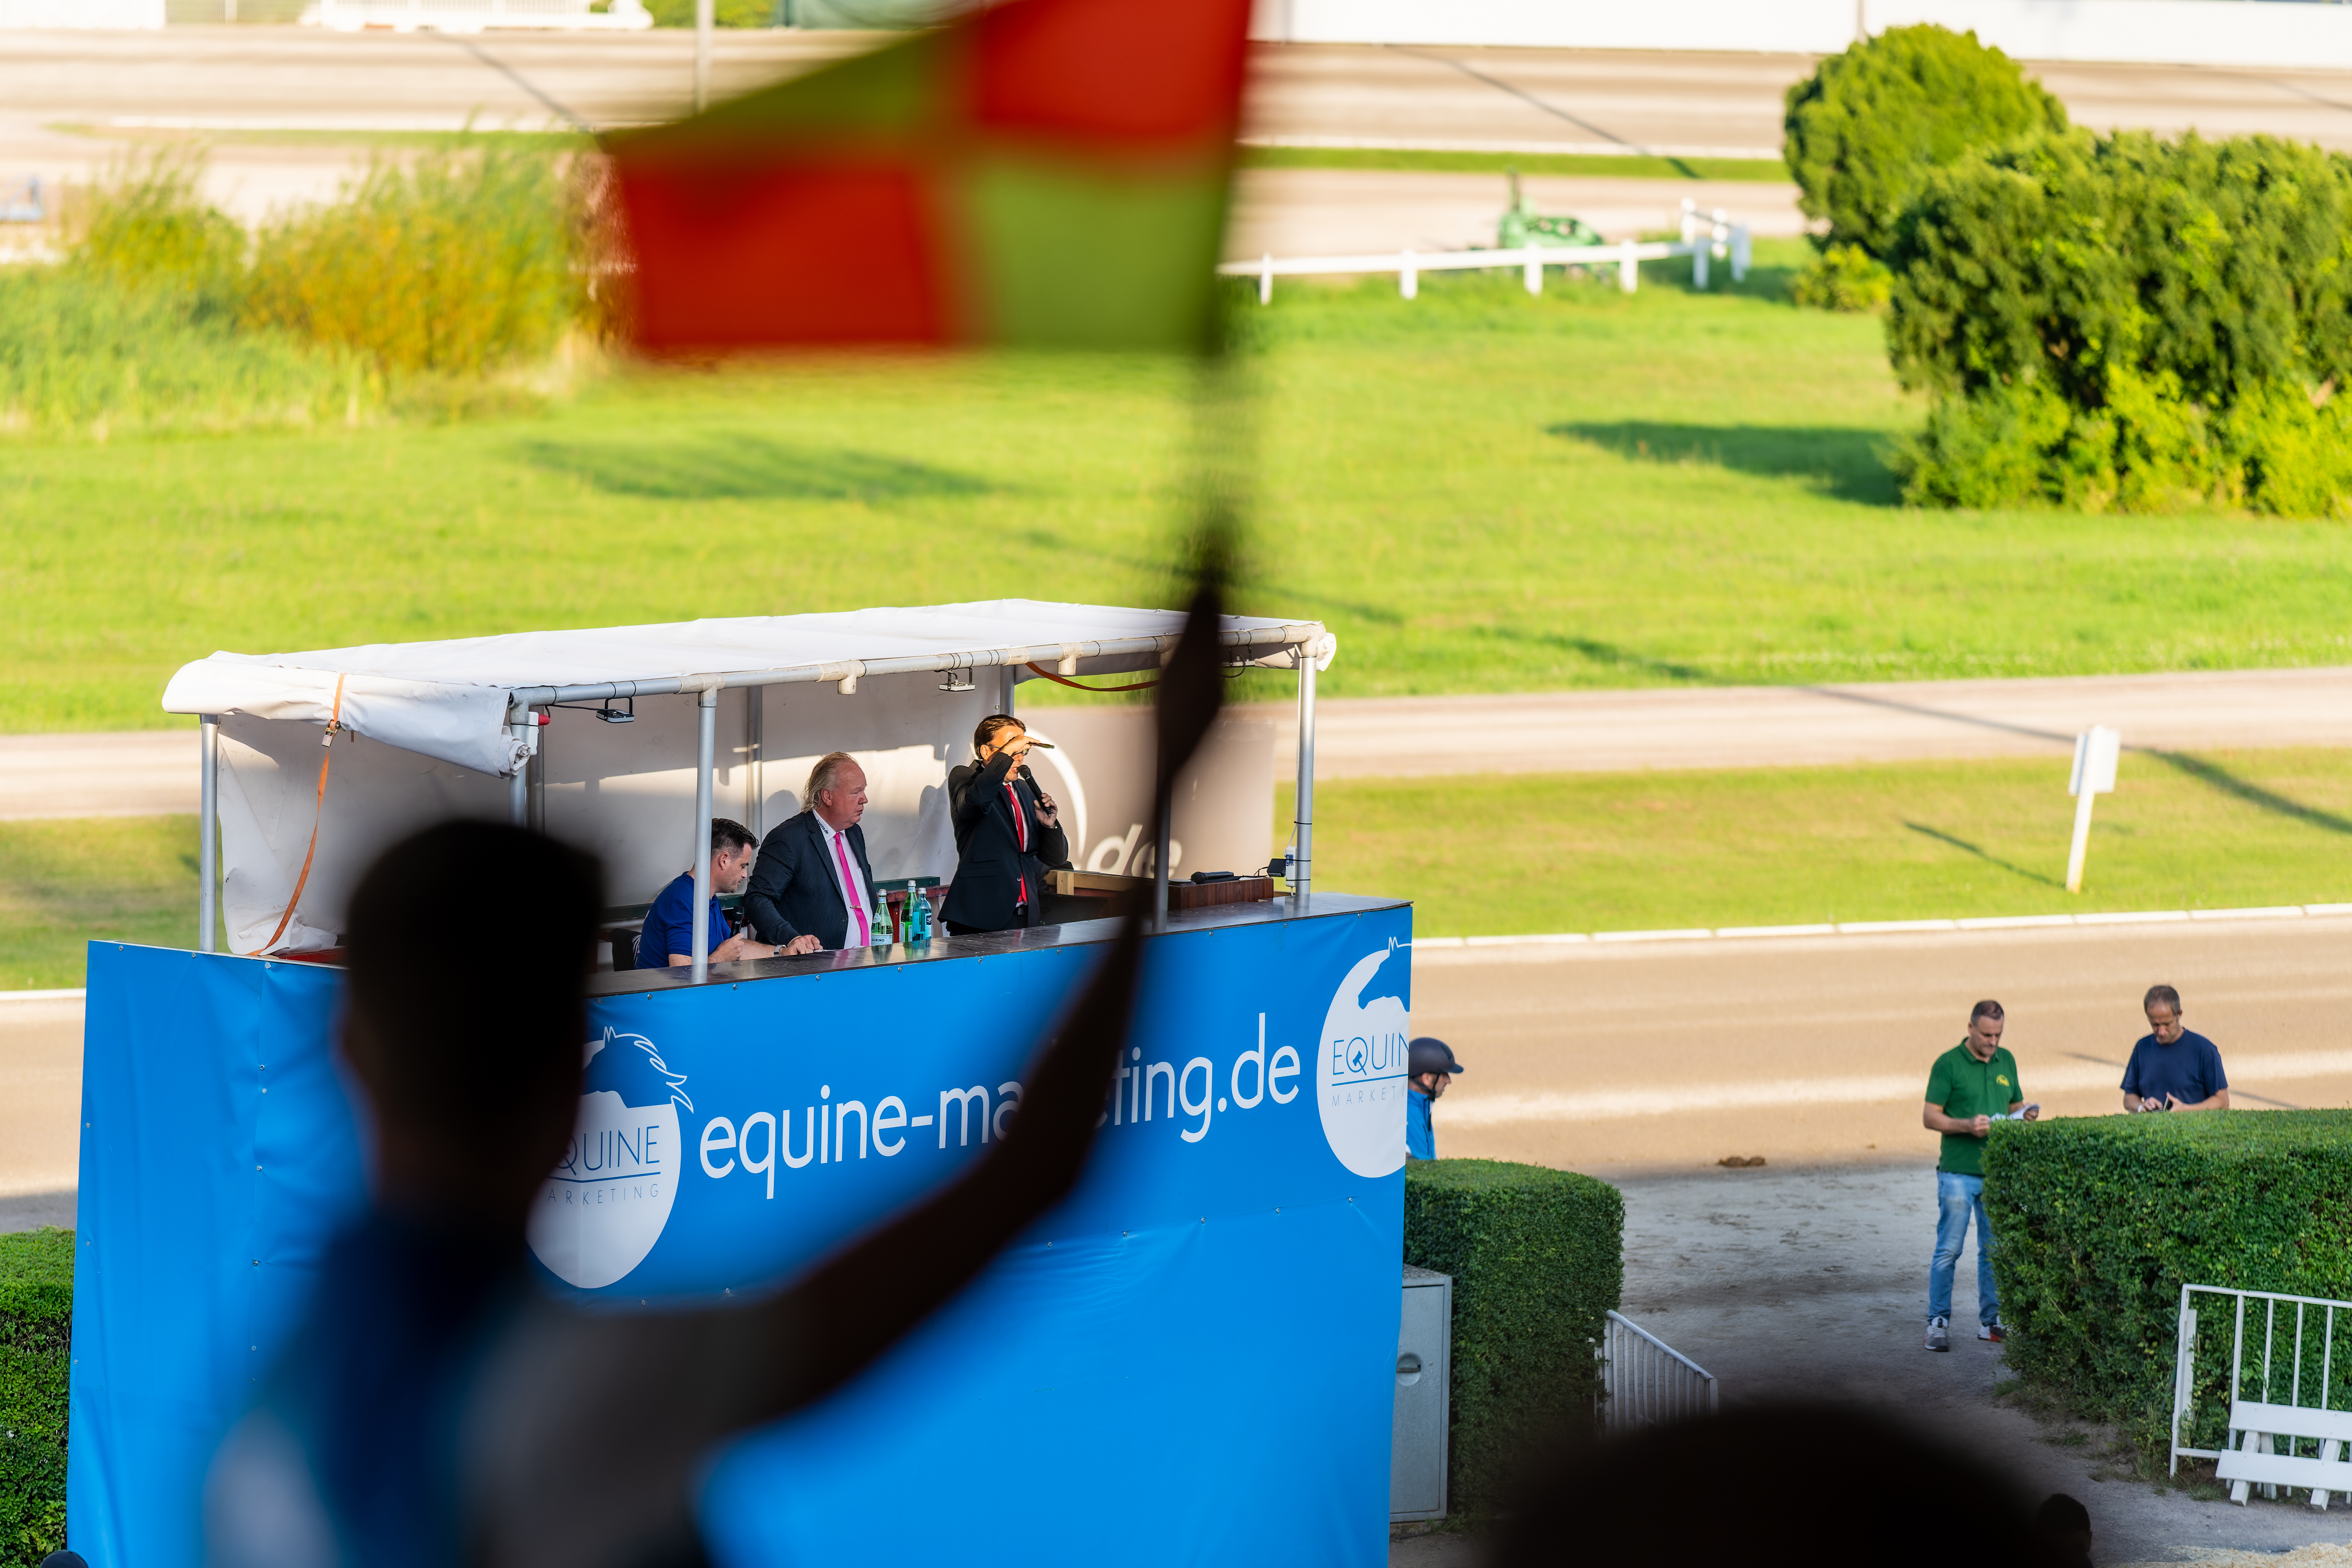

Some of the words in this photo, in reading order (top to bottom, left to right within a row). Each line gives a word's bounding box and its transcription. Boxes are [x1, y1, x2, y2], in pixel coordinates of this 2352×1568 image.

[1333, 1032, 1409, 1076] EQUIN
[700, 1013, 1301, 1199] equine-mating.de
[1332, 1085, 1404, 1107] MARKETI
[555, 1125, 660, 1176] QUINE
[548, 1184, 658, 1205] ARKETING
